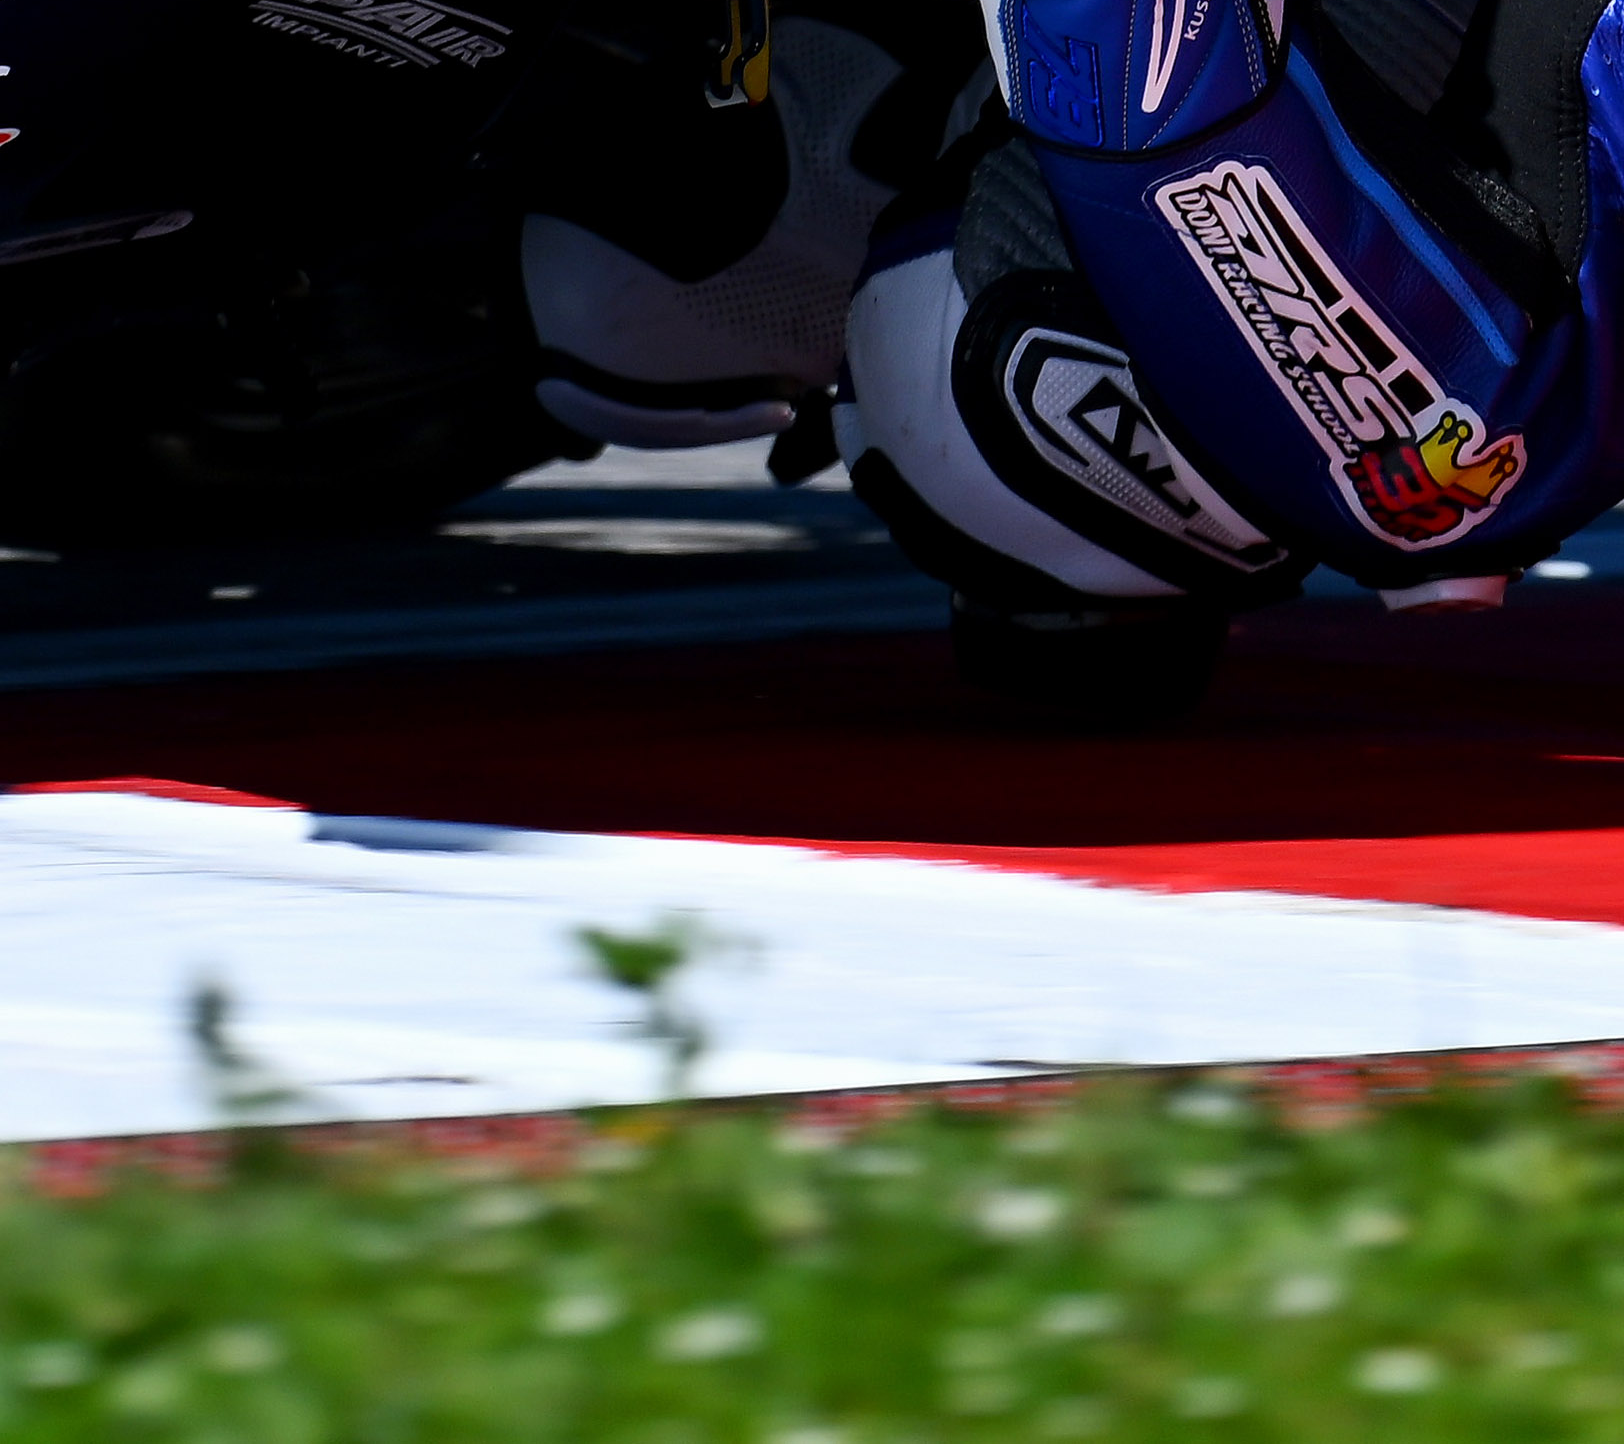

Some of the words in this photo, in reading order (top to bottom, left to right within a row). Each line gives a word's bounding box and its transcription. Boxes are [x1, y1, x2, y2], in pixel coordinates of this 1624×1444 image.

[252, 10, 410, 69] IMPIANTI
[1174, 190, 1234, 260] DONI
[1218, 253, 1295, 365] RACING
